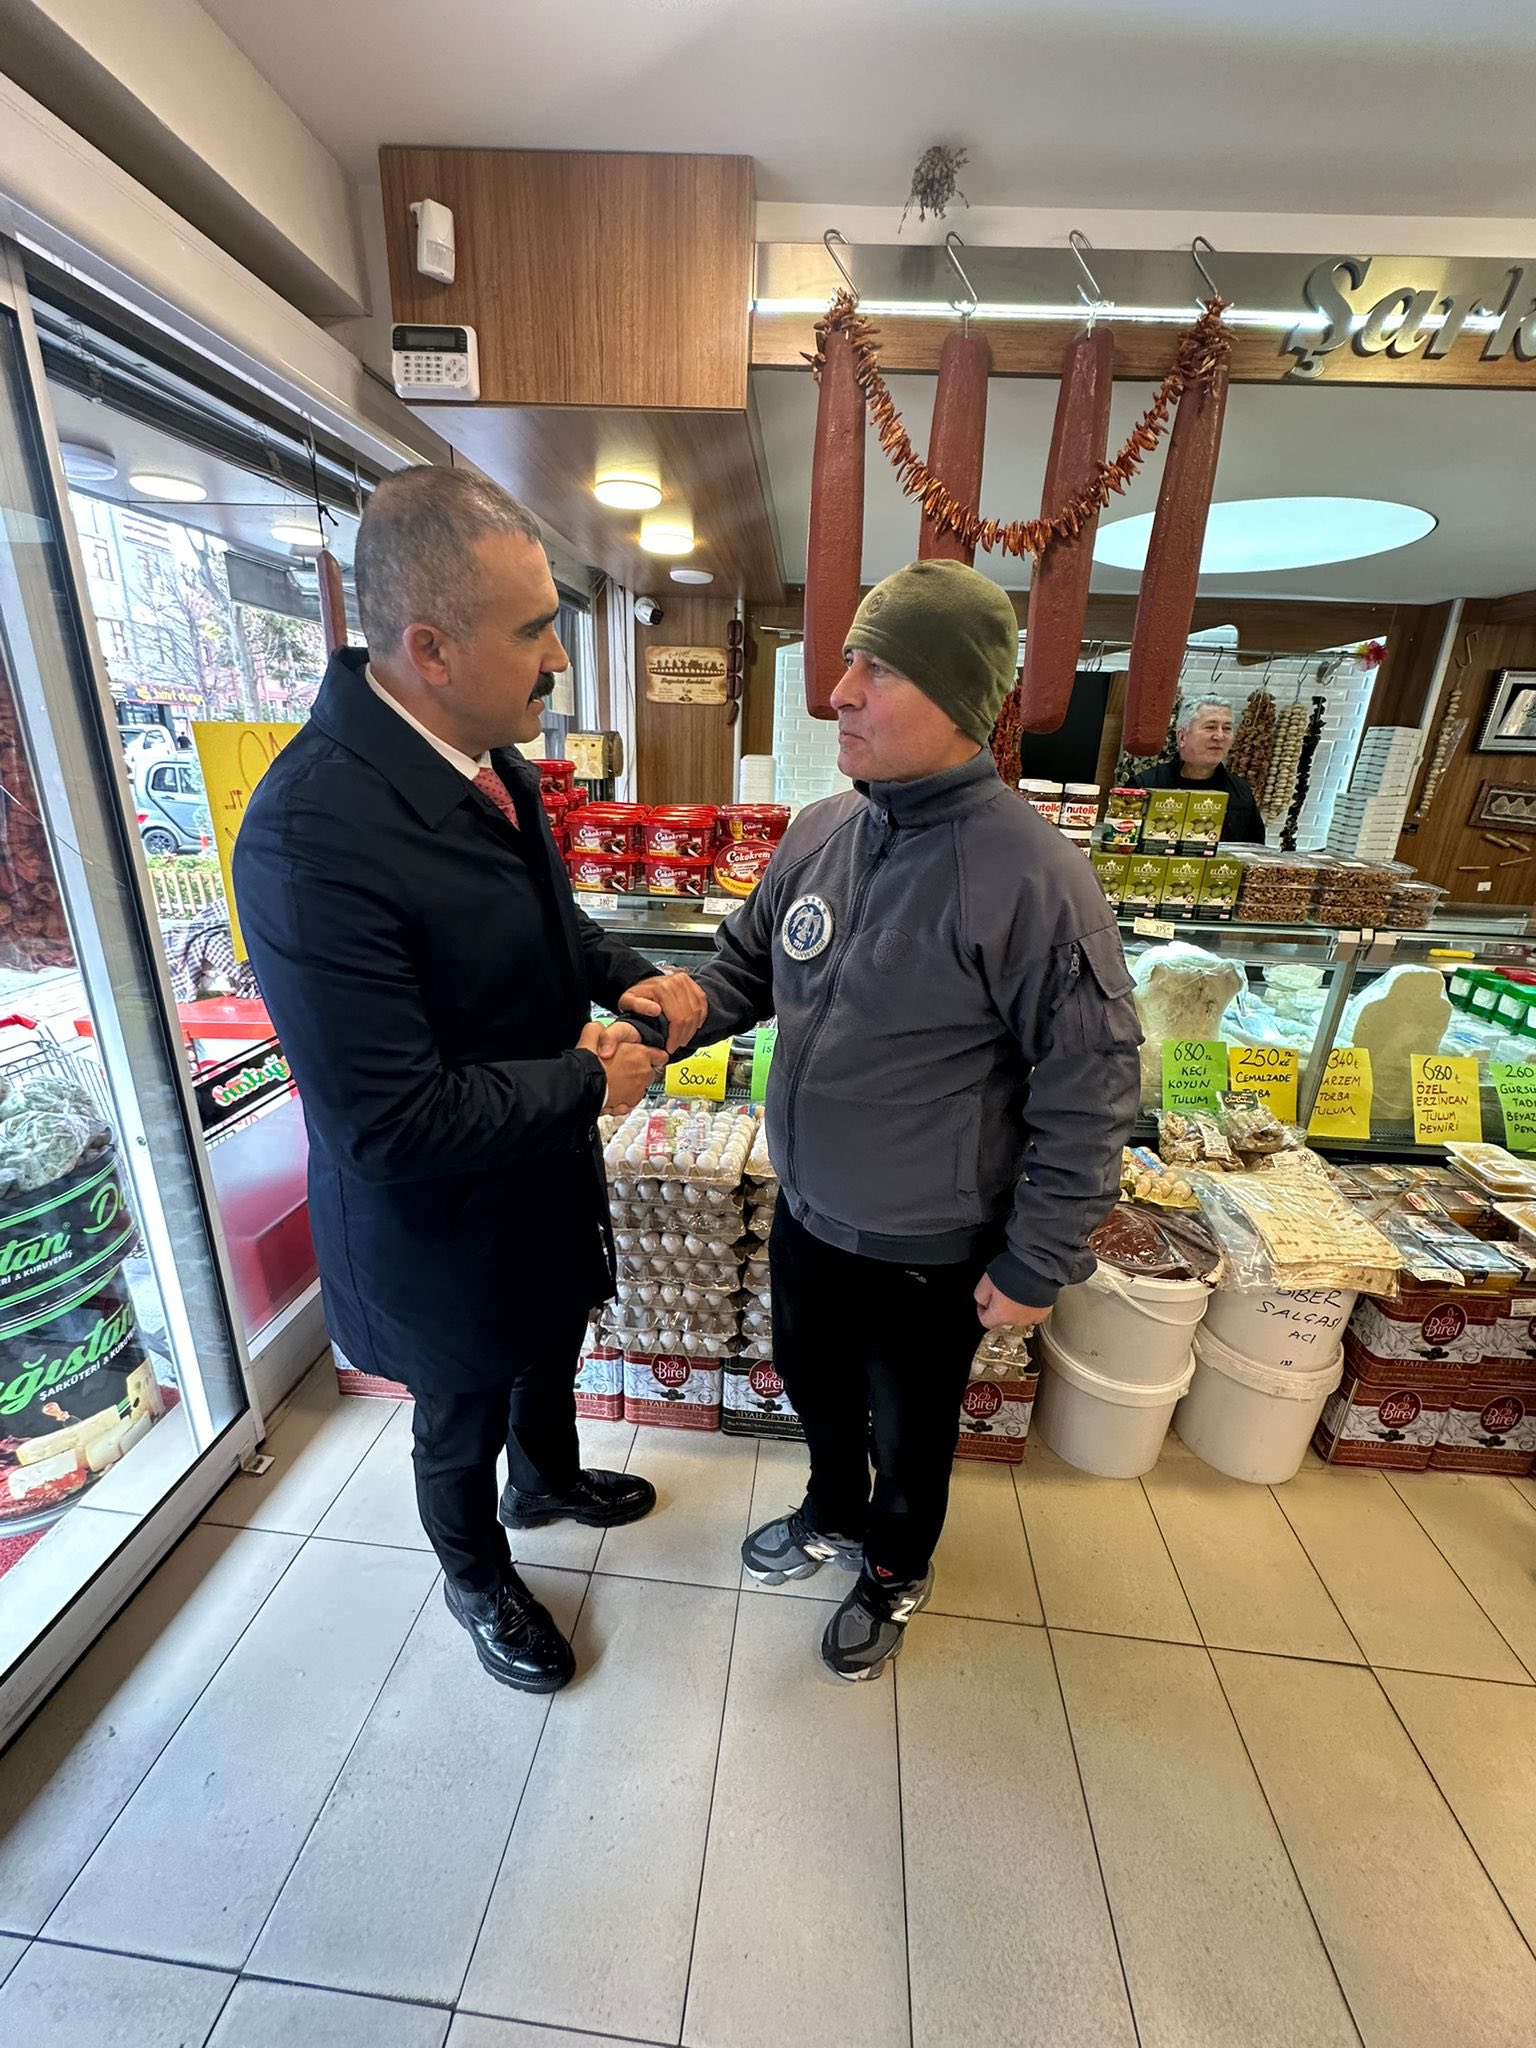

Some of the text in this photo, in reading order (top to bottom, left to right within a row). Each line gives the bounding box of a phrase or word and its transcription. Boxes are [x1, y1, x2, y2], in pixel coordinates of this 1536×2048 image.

[726, 850, 771, 866] Çokokrem
[1174, 1041, 1205, 1061] 680
[1239, 1048, 1280, 1067] 250
[1236, 1072, 1293, 1083] CEMALZADE
[1423, 1057, 1453, 1081] 680
[1505, 1064, 1535, 1078] 260
[1168, 1080, 1211, 1089] KOYUN
[1416, 1081, 1448, 1094] ÖZEL
[1171, 1095, 1208, 1104] TULUM
[1320, 1092, 1350, 1101] TORBA
[1314, 1105, 1356, 1116] TULUM
[1422, 1109, 1456, 1122] TULUM
[1506, 1111, 1536, 1122] BEYAZ
[24, 1249, 73, 1278] KURUYEMİŞ
[1424, 1317, 1460, 1338] Birel
[655, 1360, 687, 1380] Birel
[40, 1361, 101, 1402] ŞARKÜTERİ
[965, 1392, 998, 1411] Birel
[1380, 1402, 1416, 1422] Birel
[1483, 1407, 1518, 1427] Birel
